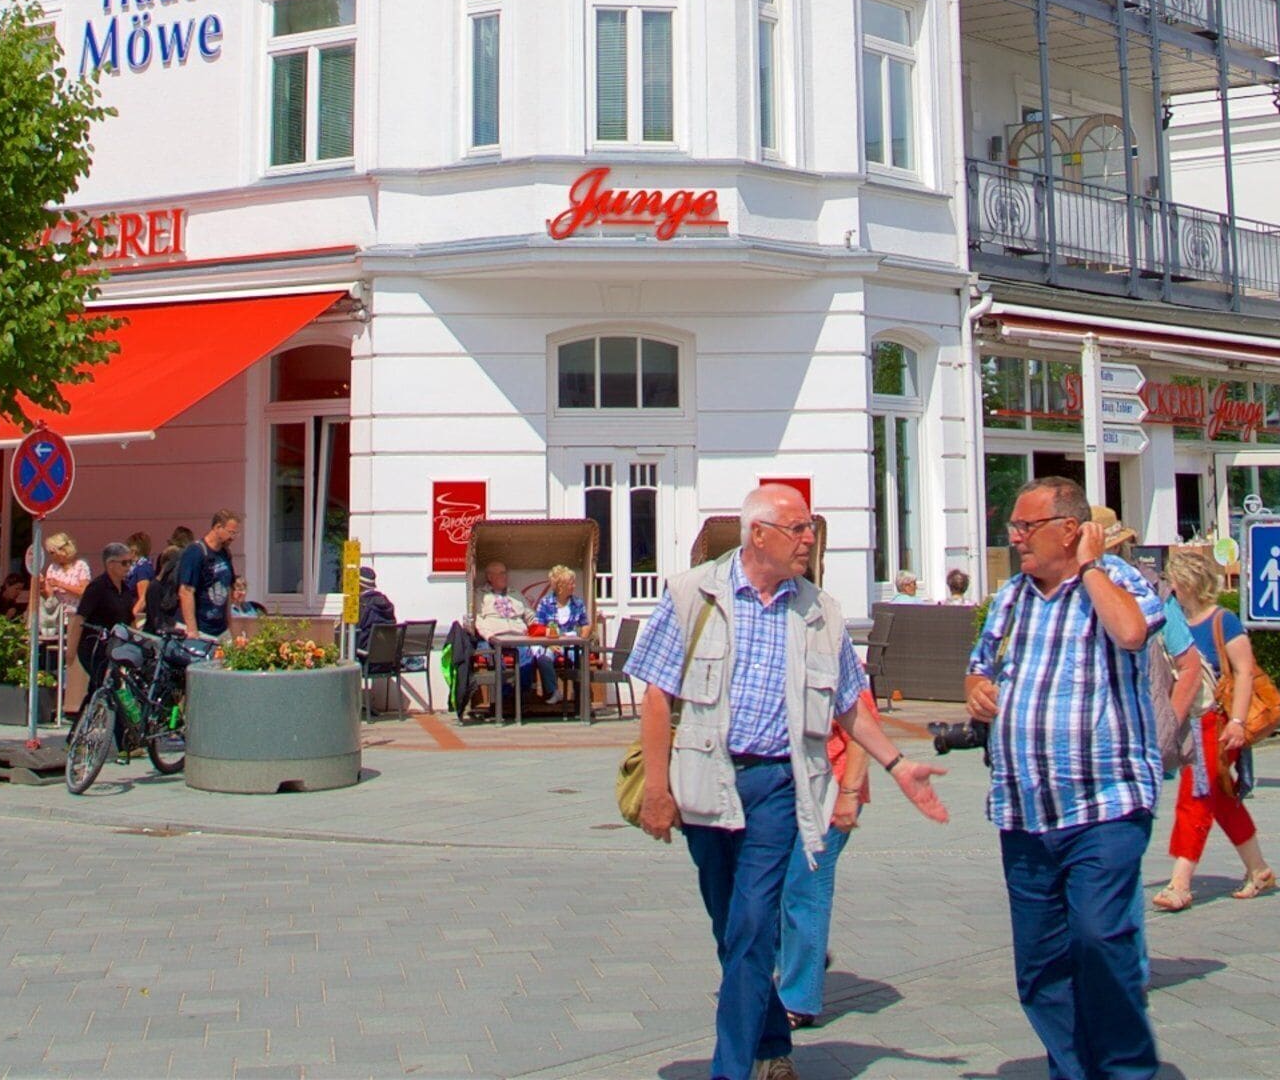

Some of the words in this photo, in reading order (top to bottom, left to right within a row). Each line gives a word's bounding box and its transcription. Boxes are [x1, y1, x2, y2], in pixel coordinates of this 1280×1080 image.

[78, 12, 223, 78] Möwe
[549, 167, 719, 240] Junge
[1208, 383, 1265, 442] Junge
